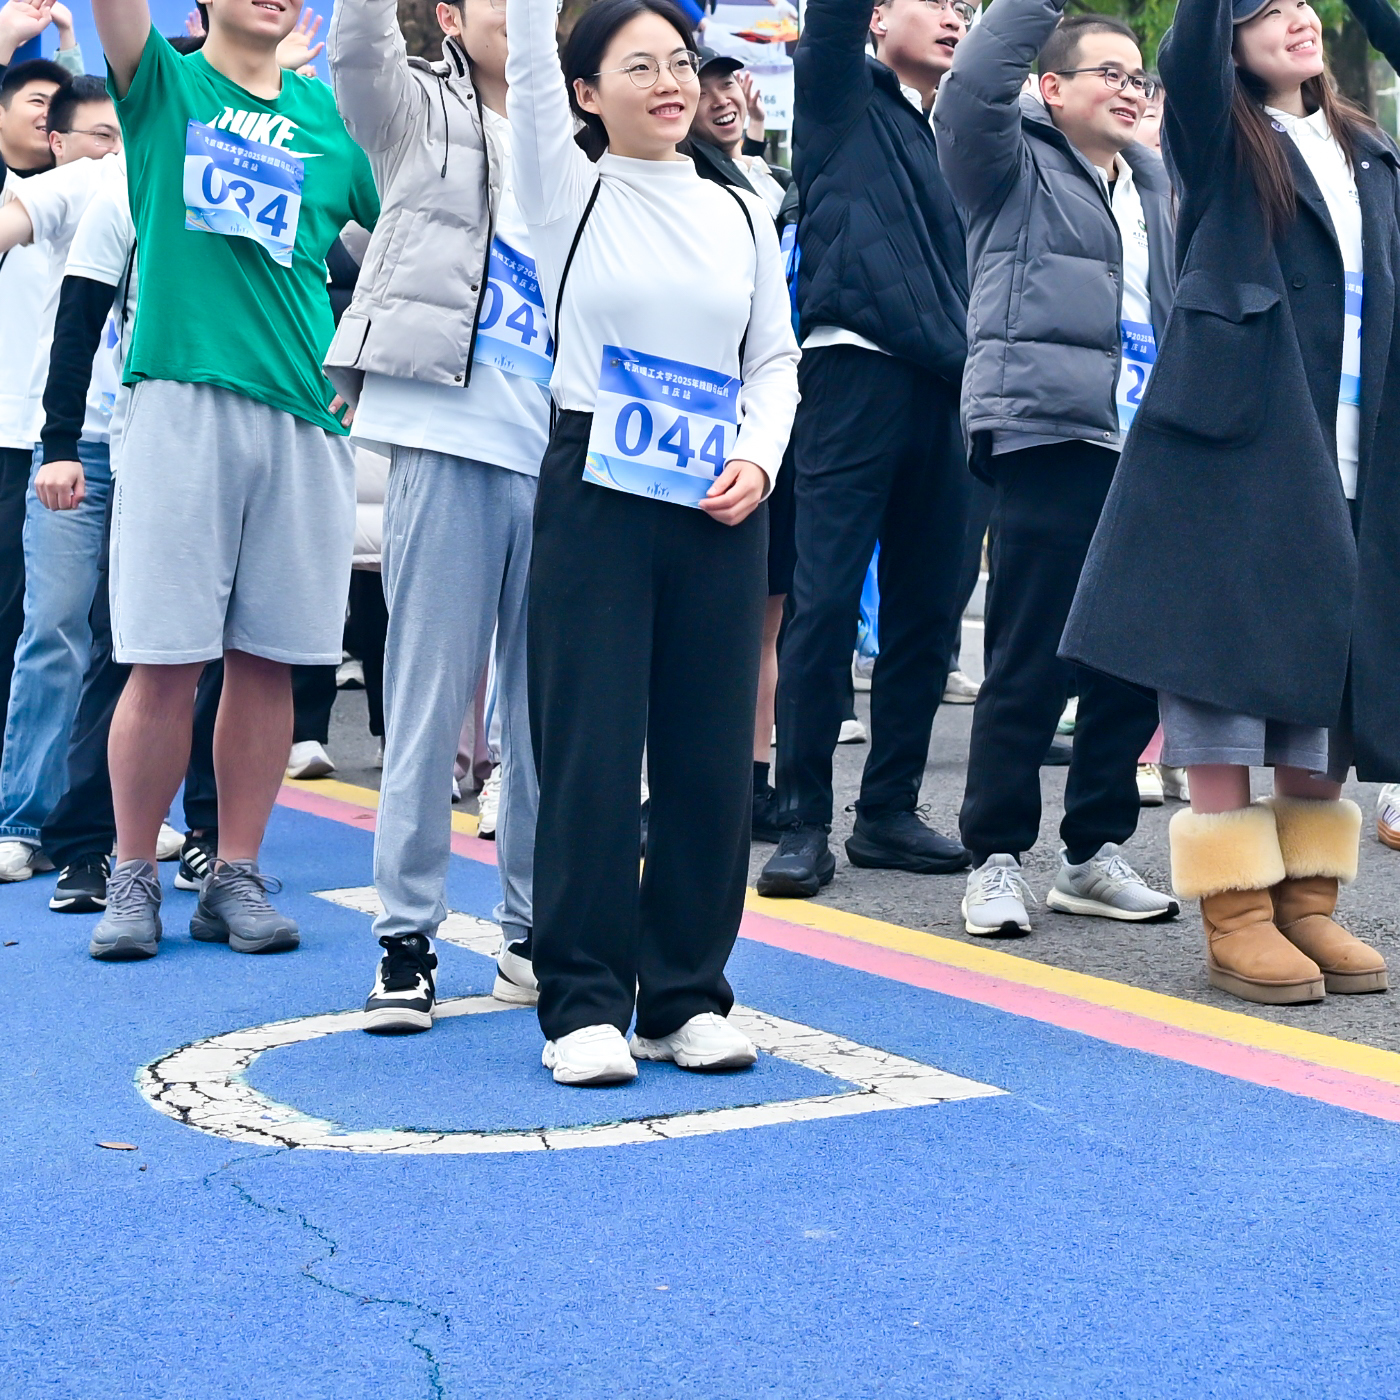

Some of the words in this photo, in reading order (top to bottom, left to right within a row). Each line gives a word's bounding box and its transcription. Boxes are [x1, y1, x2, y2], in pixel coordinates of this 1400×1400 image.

[206, 106, 300, 152] NIKE
[202, 162, 289, 238] 034
[477, 281, 554, 358] 04
[661, 385, 691, 400] 重庆站
[614, 401, 727, 477] 044
